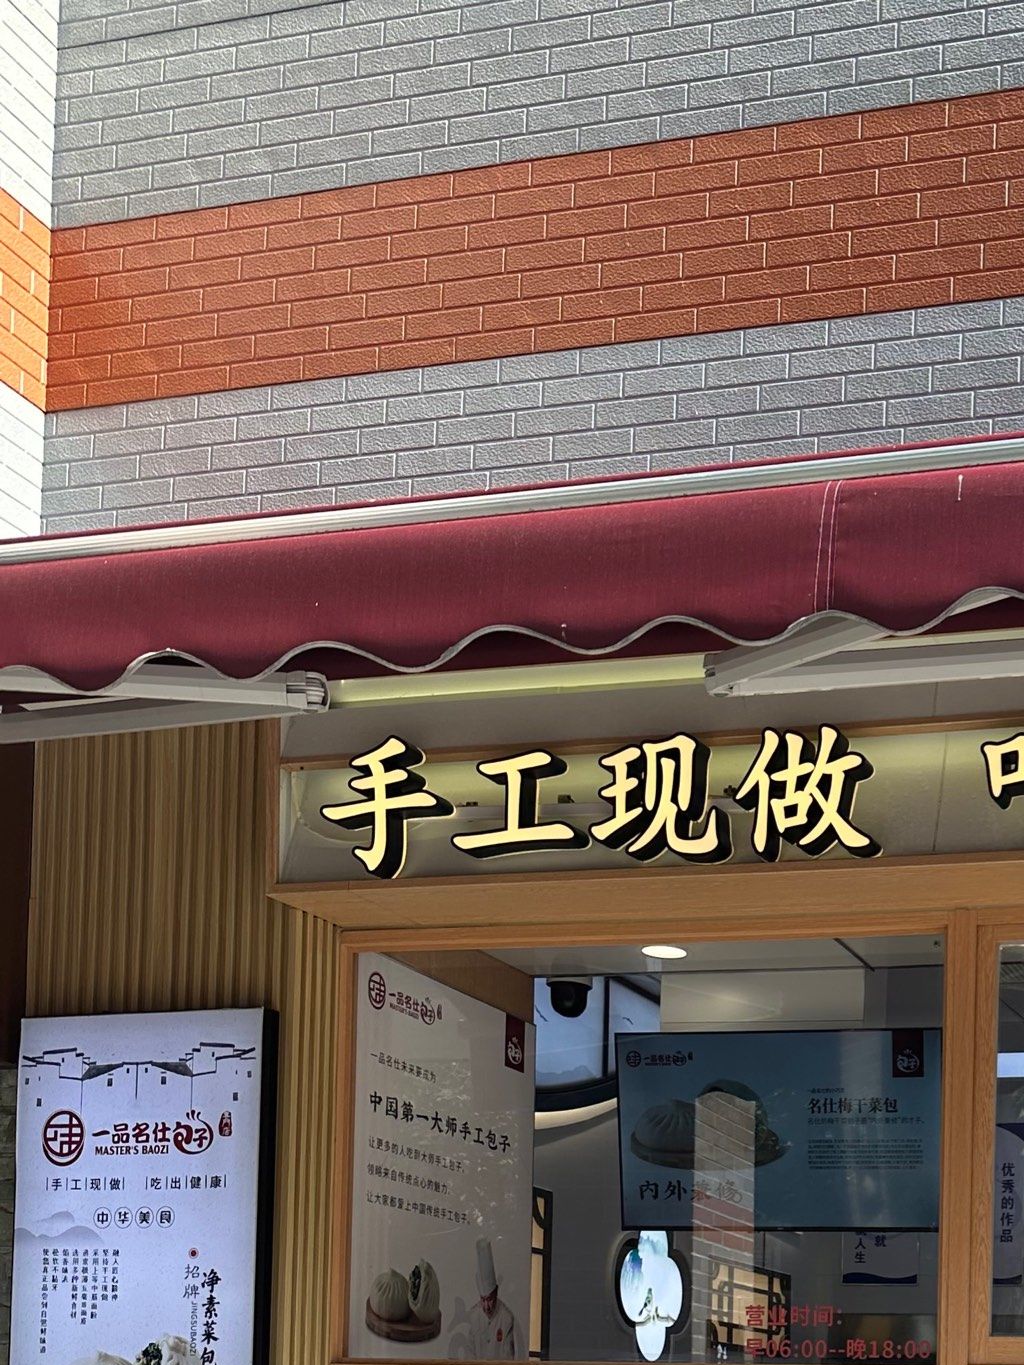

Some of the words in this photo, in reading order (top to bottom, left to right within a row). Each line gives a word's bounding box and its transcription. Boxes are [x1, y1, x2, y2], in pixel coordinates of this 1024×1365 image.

[321, 724, 883, 879] 手工现做
[92, 1115, 214, 1155] 一品名仕包子
[370, 1091, 510, 1153] 中国第一大师手工包子
[95, 1146, 139, 1156] MASTER'S
[142, 1145, 169, 1155] BAOZI
[51, 1178, 121, 1191] 手工现做
[150, 1176, 222, 1190] 吃出健康
[97, 1211, 172, 1226] 中华美食
[1000, 1162, 1015, 1243] 优秀的作品
[183, 1263, 200, 1299] 招牌
[746, 1304, 842, 1327] 营业时间：
